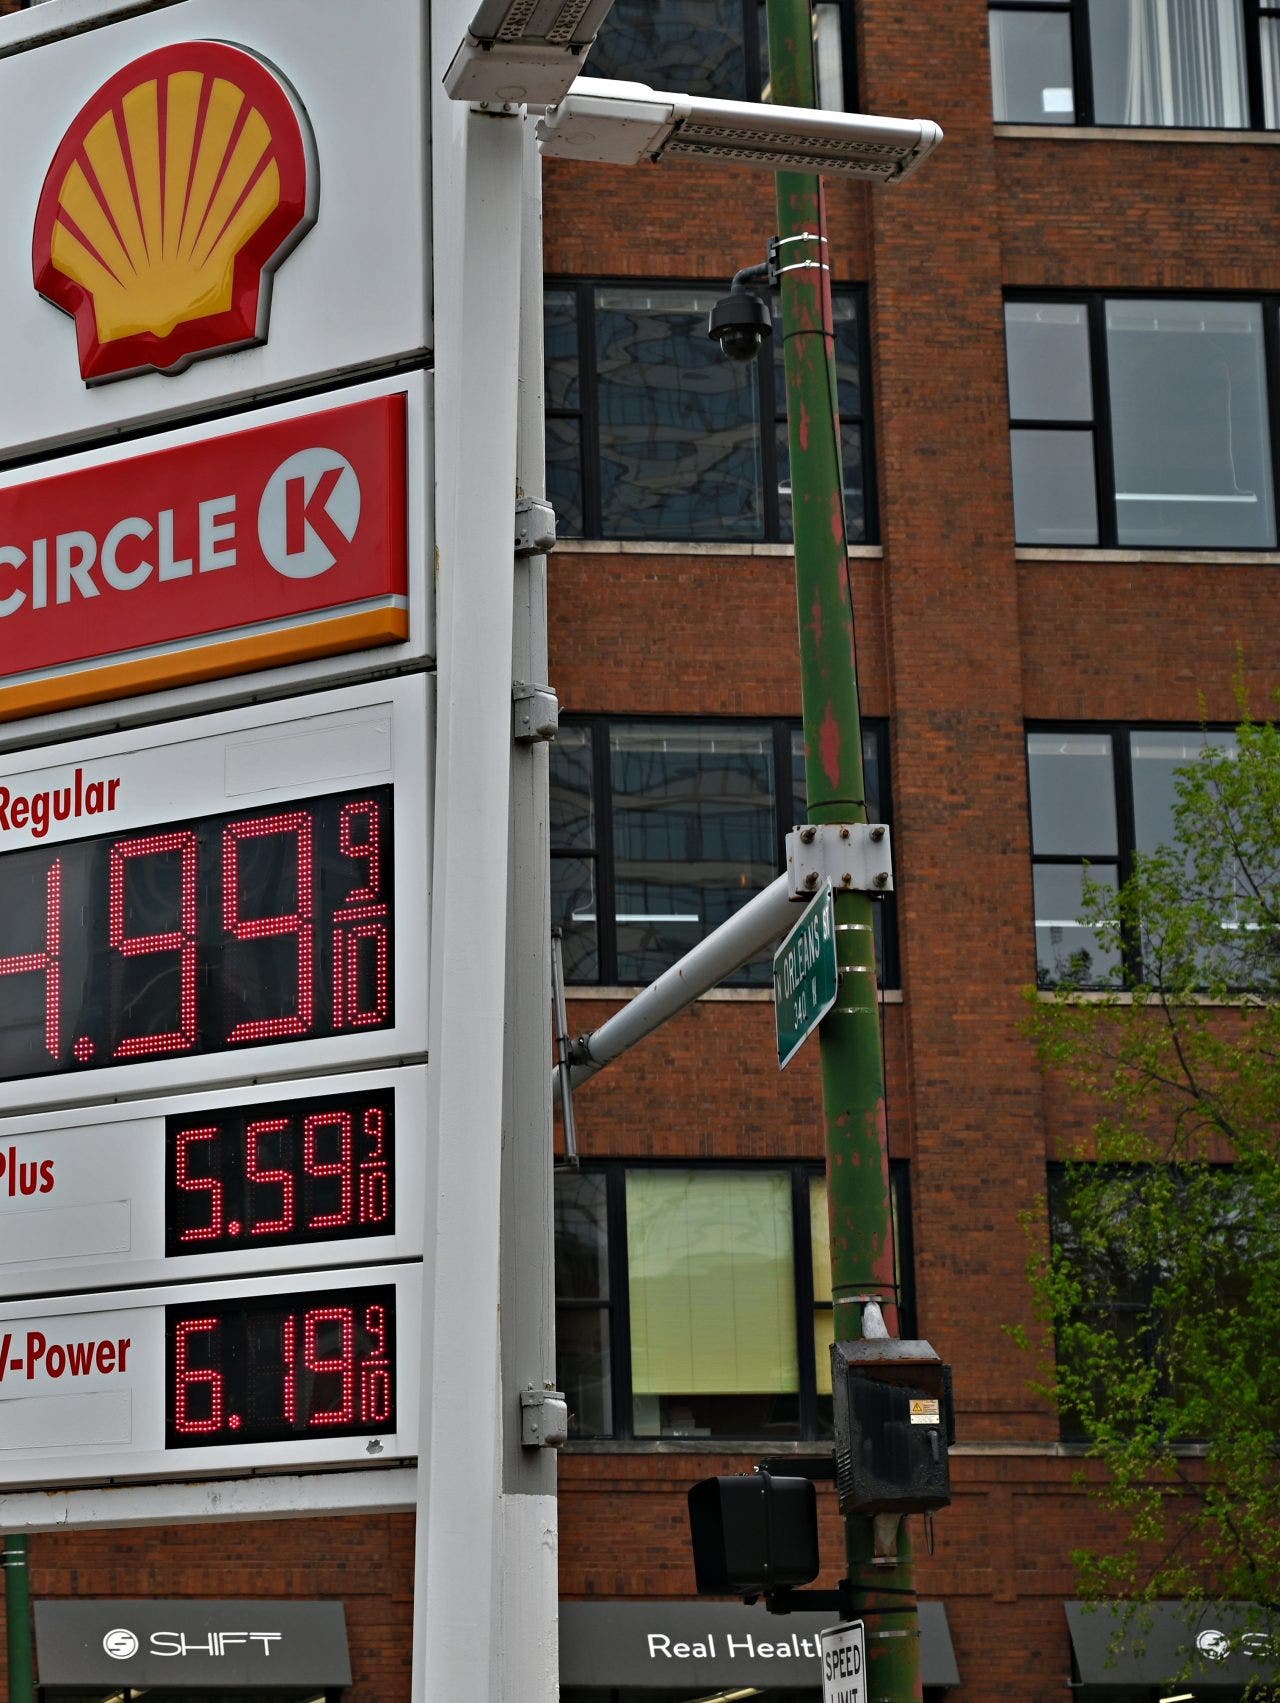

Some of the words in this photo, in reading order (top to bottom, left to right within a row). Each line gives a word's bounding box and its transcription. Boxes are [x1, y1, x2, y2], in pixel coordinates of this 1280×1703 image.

[280, 462, 356, 566] K
[783, 914, 821, 1000] ORLEANS
[793, 990, 808, 1031] 340
[176, 1111, 353, 1241] 5.59
[175, 1307, 353, 1433] 6.19
[149, 1631, 282, 1657] SHIFT
[647, 1633, 716, 1658] Real
[825, 1644, 861, 1682] SPEED
